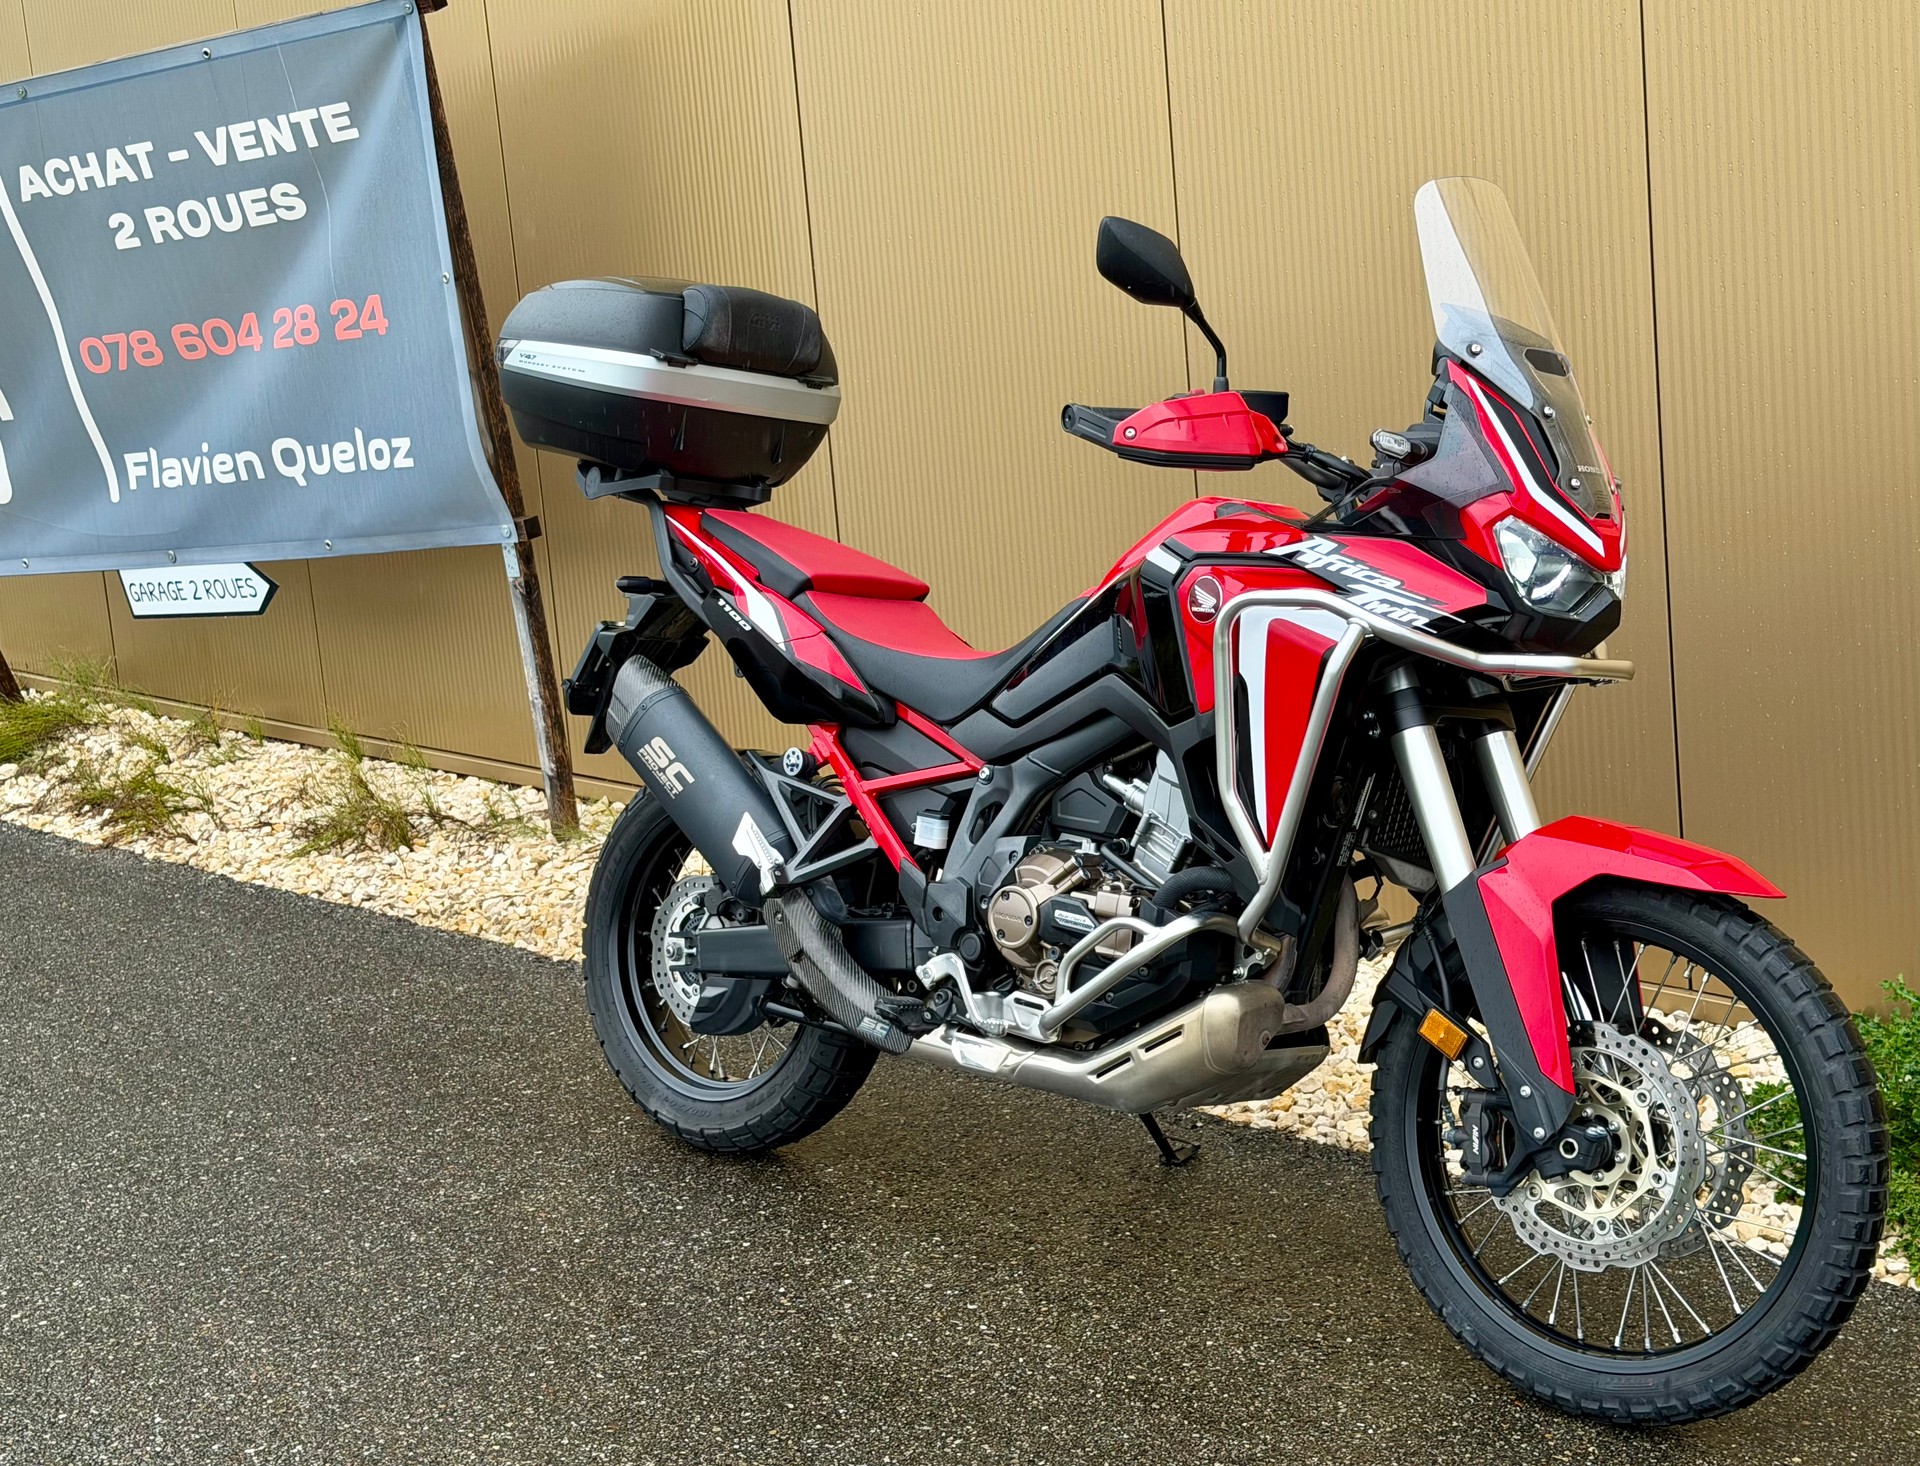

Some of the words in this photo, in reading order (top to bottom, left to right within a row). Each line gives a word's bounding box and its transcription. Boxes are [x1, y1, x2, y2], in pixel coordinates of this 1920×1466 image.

[19, 142, 154, 203] ACHAT
[167, 149, 190, 162] -
[193, 102, 360, 167] VENTE
[108, 212, 142, 250] 2
[144, 182, 308, 244] ROUES
[79, 330, 164, 375] 078
[171, 312, 263, 361] 604
[273, 304, 320, 349] 28
[330, 294, 389, 341] 24
[123, 441, 266, 491] Flavien
[271, 427, 415, 487] Queloz
[129, 581, 187, 602] GARAGE
[189, 580, 202, 600] 2
[203, 578, 258, 600] ROUES
[1262, 535, 1410, 594] Africa
[717, 598, 752, 631] 1100
[1191, 606, 1216, 614] HONDA
[1347, 583, 1440, 634] Twin
[637, 747, 680, 796] PROJECT
[643, 736, 696, 793] SC
